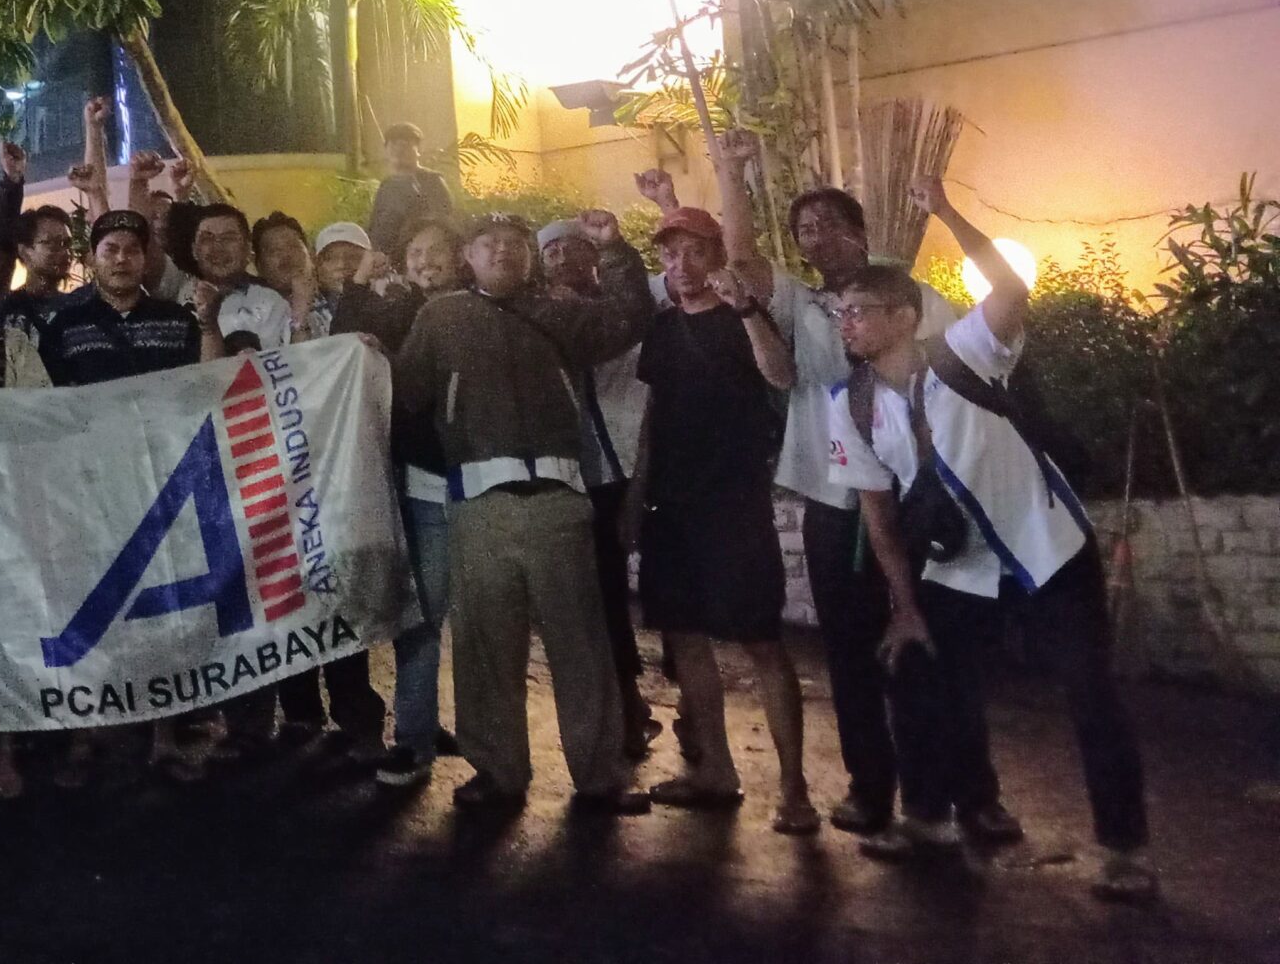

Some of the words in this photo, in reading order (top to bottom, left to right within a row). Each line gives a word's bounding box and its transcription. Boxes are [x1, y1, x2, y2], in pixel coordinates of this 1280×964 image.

[259, 350, 312, 484] INDUSTRI
[295, 487, 337, 594] ANEKA
[39, 681, 136, 719] PCAI
[148, 614, 360, 708] SURABAYA
